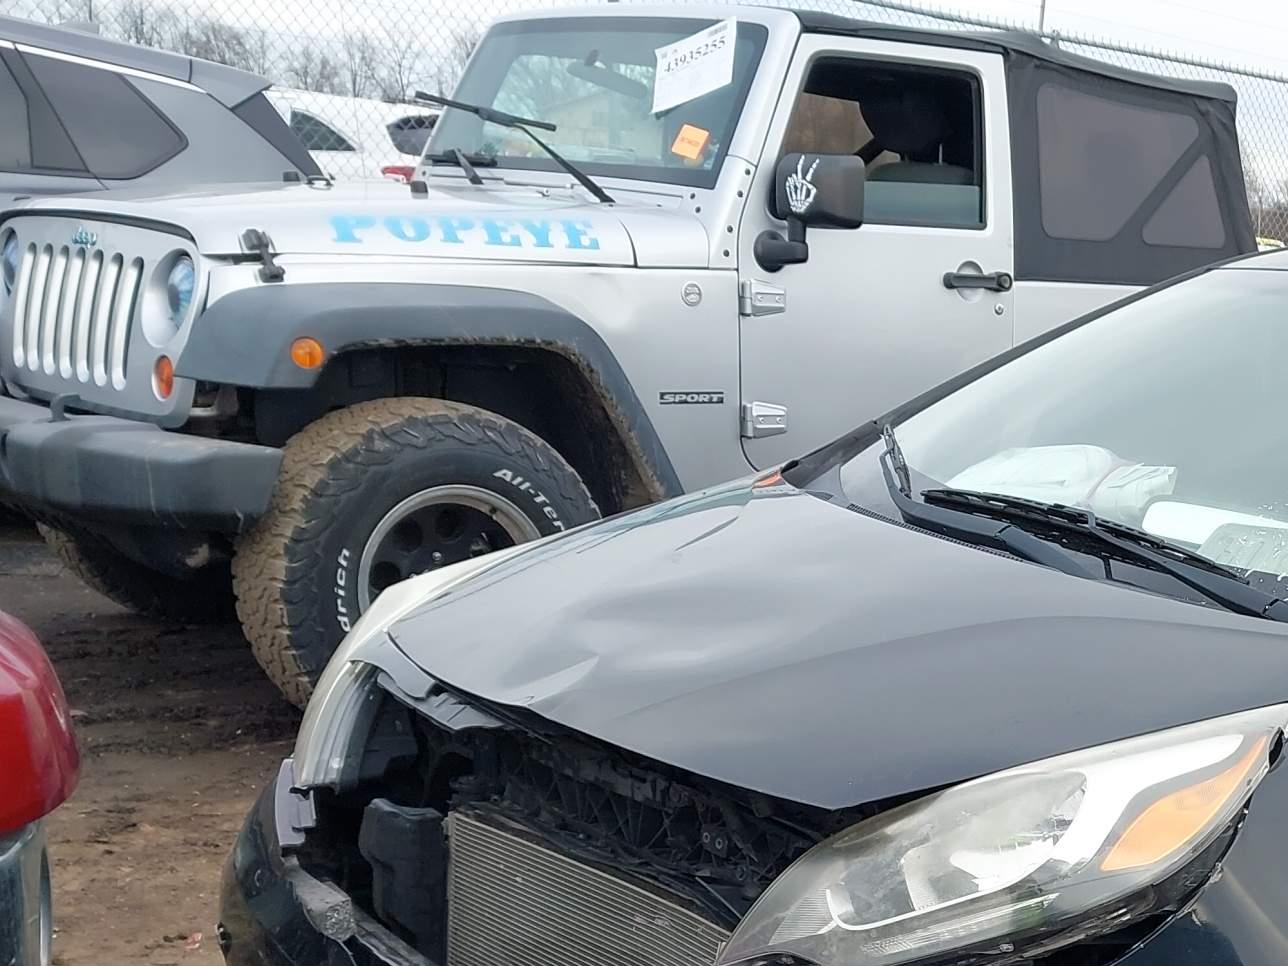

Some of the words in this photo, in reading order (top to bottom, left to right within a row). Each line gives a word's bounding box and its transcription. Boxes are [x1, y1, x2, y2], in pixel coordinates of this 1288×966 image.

[663, 35, 726, 73] 43935255
[329, 215, 600, 250] POPEYE
[662, 393, 723, 403] SPORT
